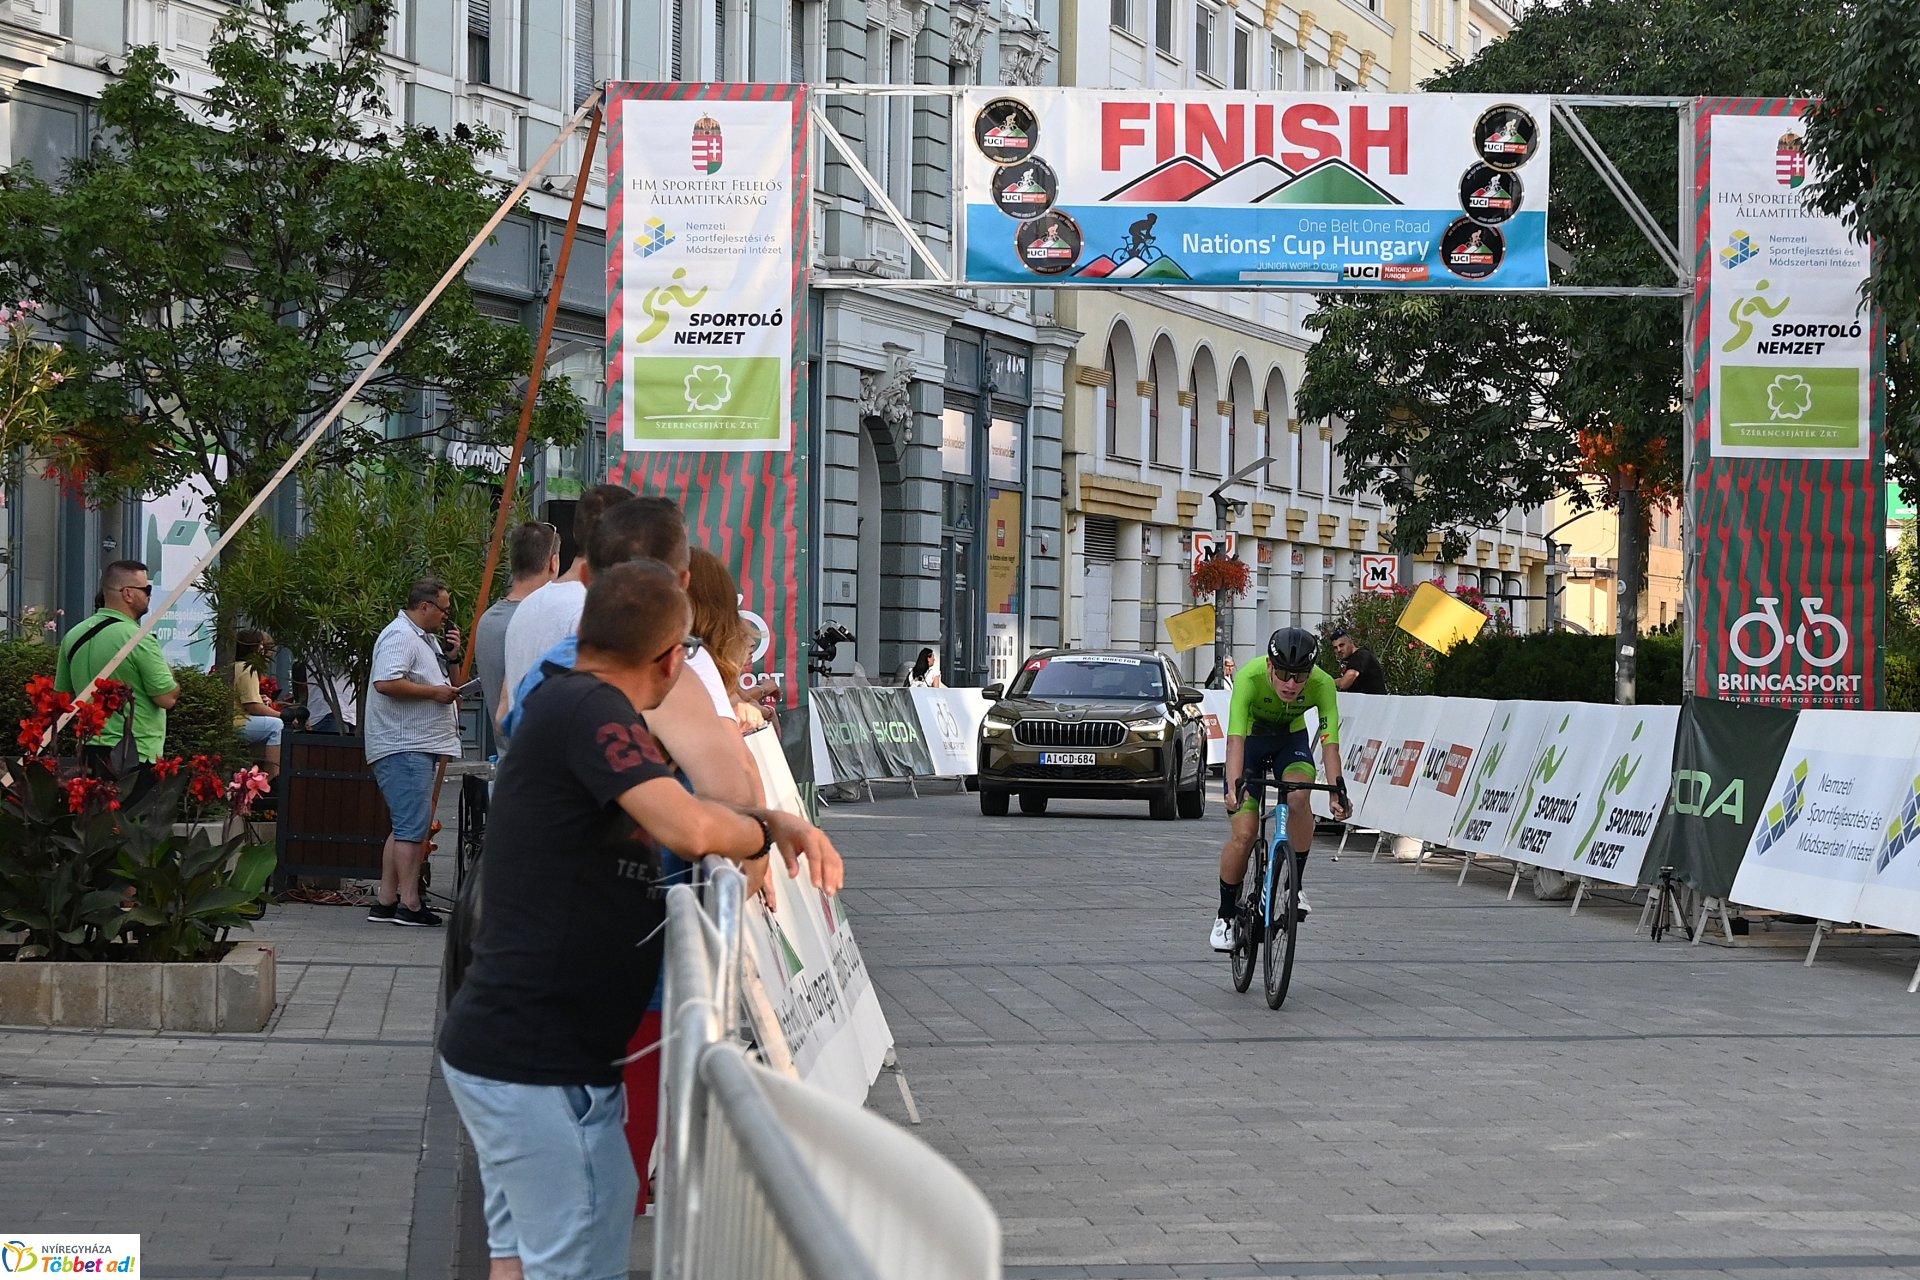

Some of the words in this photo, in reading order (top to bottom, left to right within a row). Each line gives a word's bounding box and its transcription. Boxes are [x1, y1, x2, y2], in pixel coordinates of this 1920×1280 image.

[1101, 101, 1409, 175] FINISH
[632, 179, 657, 191] HM
[651, 192, 767, 206] ÁLLAMTITKÁRSÁG
[1718, 192, 1742, 204] HM
[686, 222, 726, 231] Nemzeti
[1299, 218, 1327, 233] One
[1332, 218, 1358, 233] Belt
[1363, 219, 1391, 233] One
[1395, 219, 1430, 233] Road
[686, 234, 762, 244] Sportfejlesztési
[764, 234, 776, 243] és
[1769, 234, 1807, 244] Nemzeti
[686, 246, 747, 255] Módszertani
[749, 246, 782, 256] Intézet
[1183, 234, 1276, 255] Nations'
[1284, 235, 1325, 260] Cup
[1334, 235, 1430, 261] Hungary
[1769, 246, 1842, 257] Sportfejlesztési
[1843, 247, 1855, 257] és
[1257, 261, 1288, 270] JUNIOR
[1289, 262, 1319, 270] WORLD
[1769, 257, 1828, 268] Módszertani
[1830, 258, 1861, 268] Intézet
[1350, 266, 1380, 278] UCI
[689, 308, 783, 327] SPORTOLÓ
[1771, 320, 1862, 338] SPORTOLÓ
[674, 331, 745, 345] NEMZET
[1757, 341, 1825, 355] NEMZET
[1370, 567, 1388, 581] M
[1029, 661, 1041, 669] A
[1718, 673, 1862, 692] BRINGASPORT
[1818, 772, 1856, 796] Nemzeti
[1478, 784, 1518, 814] SPORTOLÓ
[1533, 792, 1582, 825] SPORTOLÓ
[1605, 803, 1657, 838] SPORTOLÓ
[1807, 802, 1873, 831] Sportfejlesztési
[1870, 811, 1882, 831] és
[1517, 827, 1552, 855] NEMZET
[1796, 831, 1848, 858] Módszertani
[1586, 841, 1625, 870] NEMZET
